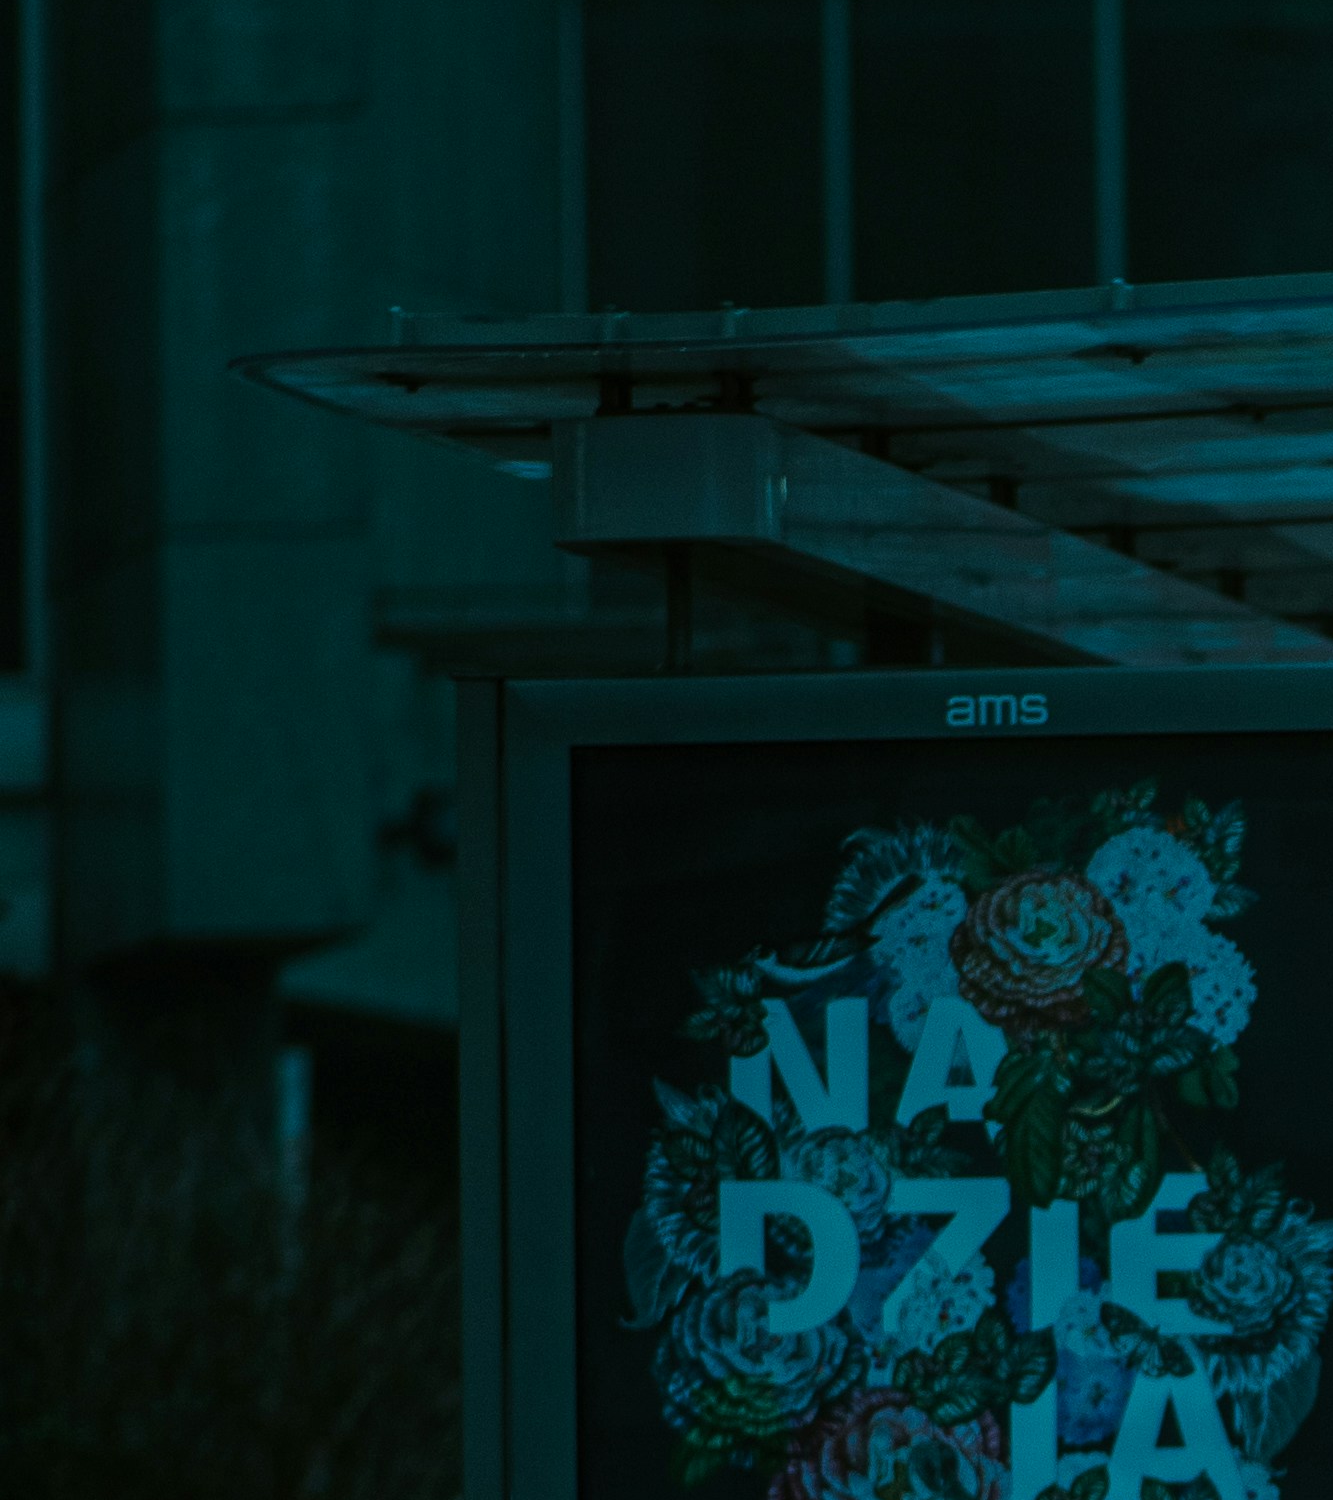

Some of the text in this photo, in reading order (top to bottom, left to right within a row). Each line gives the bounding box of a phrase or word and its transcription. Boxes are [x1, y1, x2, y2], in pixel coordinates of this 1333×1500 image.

[945, 690, 1049, 728] ams
[730, 997, 1008, 1145] NA
[719, 1171, 1235, 1335] DZIE
